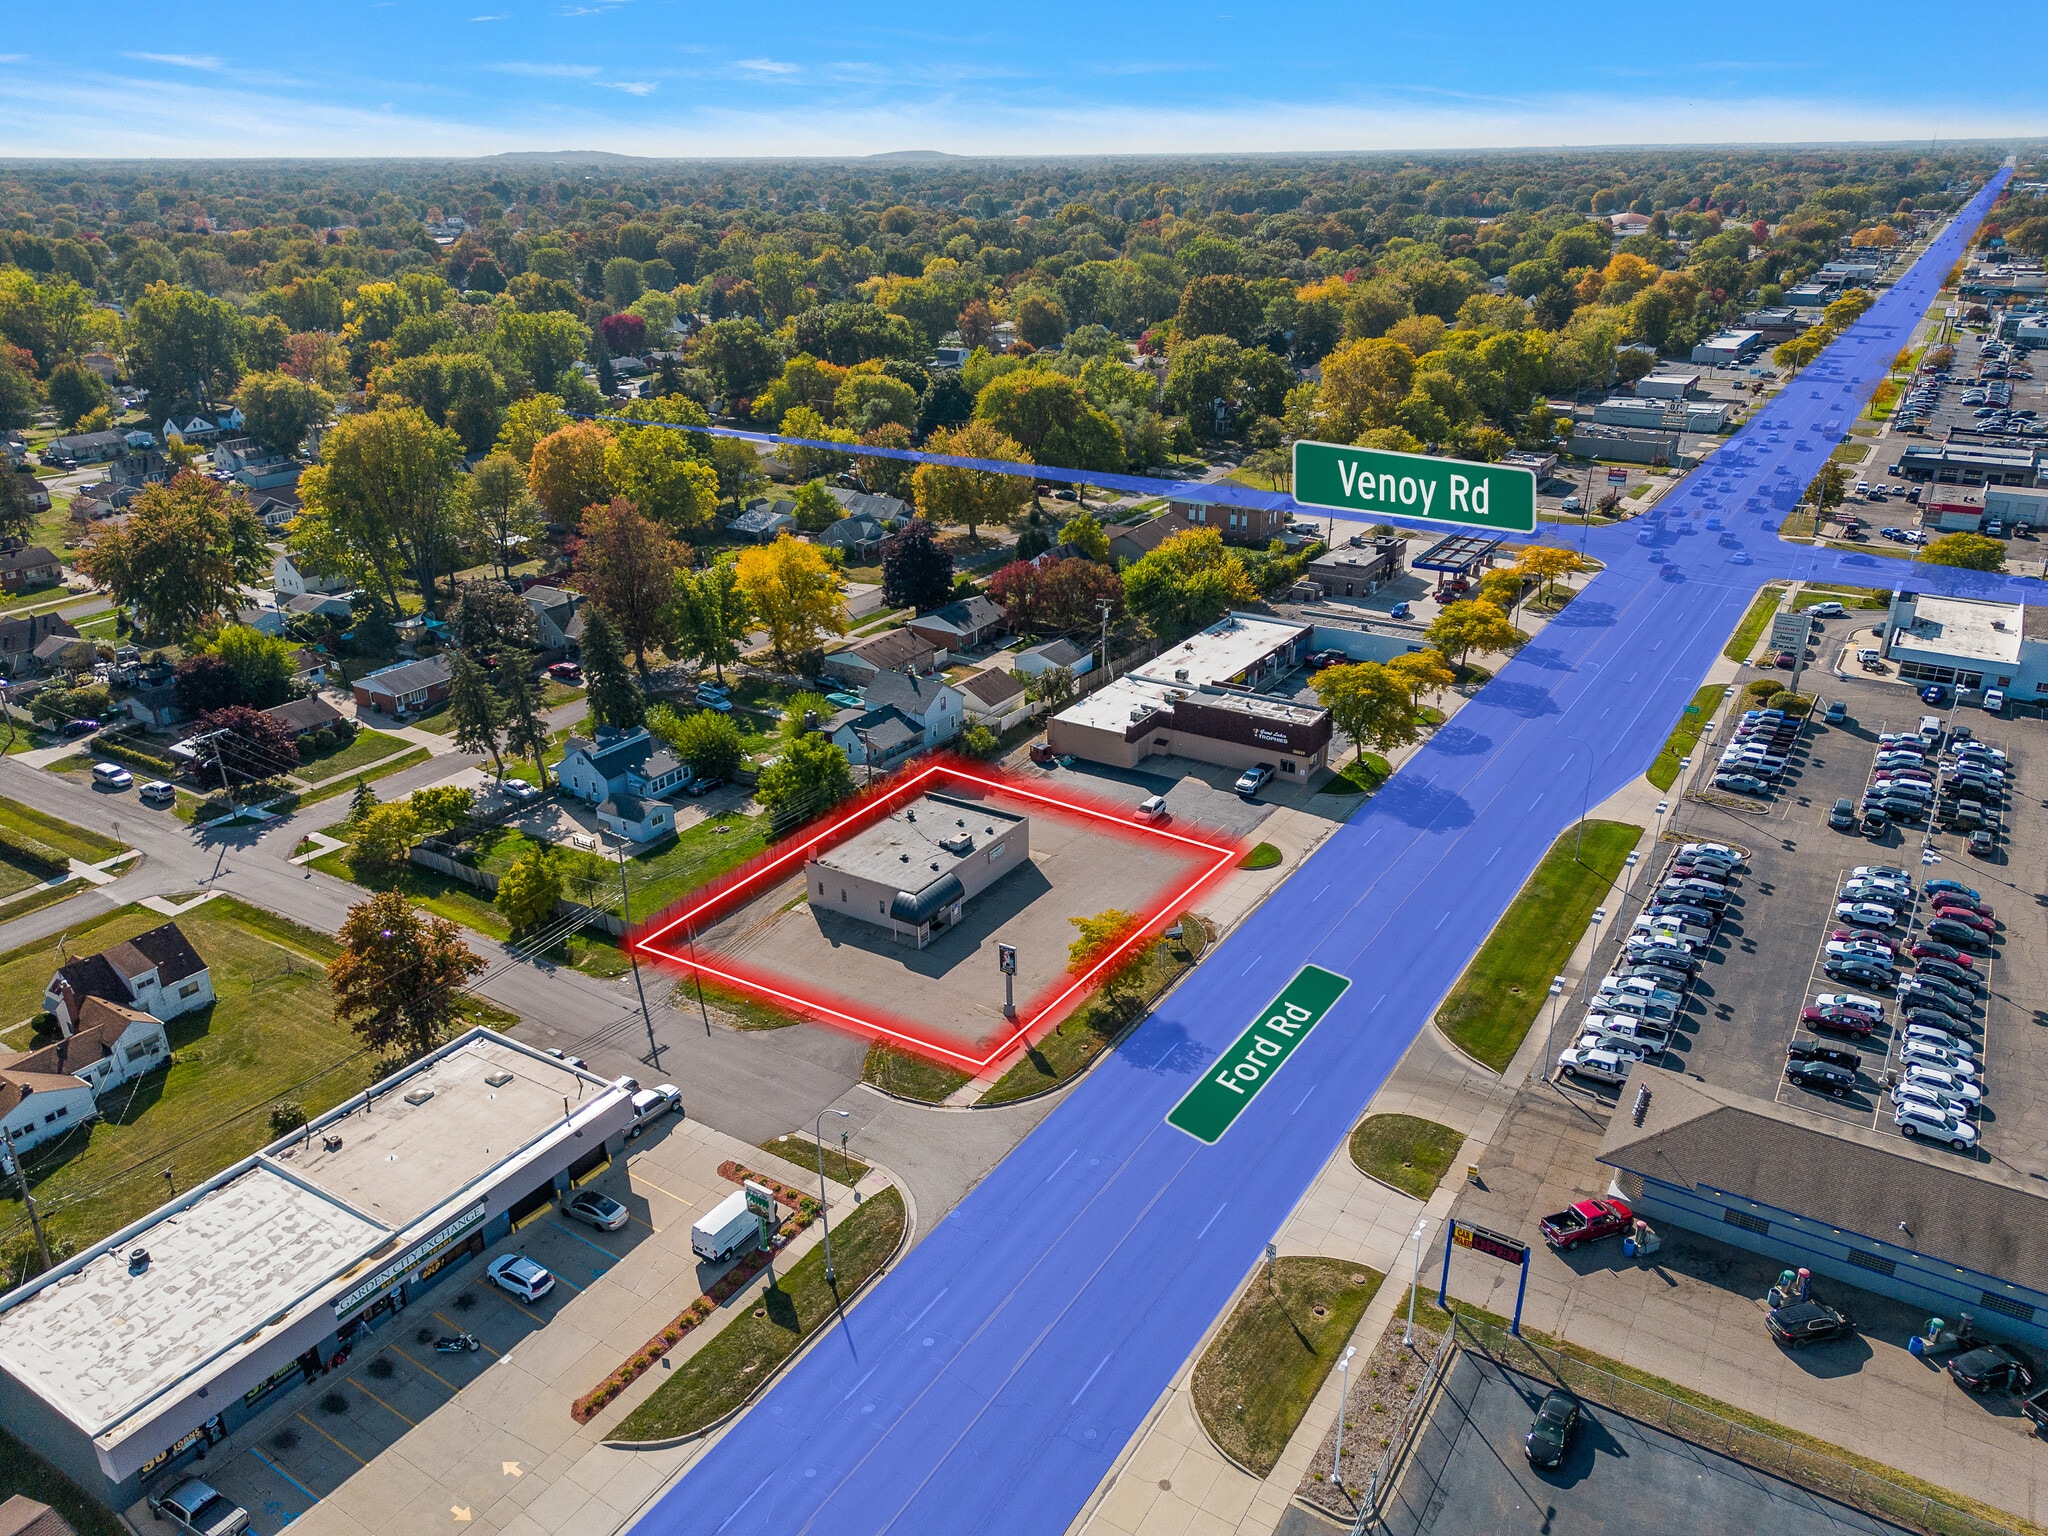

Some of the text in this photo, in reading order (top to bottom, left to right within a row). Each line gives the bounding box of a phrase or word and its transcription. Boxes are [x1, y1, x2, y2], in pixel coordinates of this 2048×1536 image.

[1777, 634, 1794, 642] Jeep
[1258, 734, 1288, 743] TROPHIES
[1457, 1229, 1471, 1240] CAR
[340, 1269, 390, 1310] GARDEN
[392, 1251, 419, 1273] CITY
[420, 1207, 482, 1253] EXCHANGE
[1473, 1237, 1520, 1263] OPEN
[381, 1276, 398, 1290] BUY
[404, 1259, 422, 1273] SELL
[428, 1238, 453, 1256] TRADE
[172, 1427, 201, 1451] LOANS
